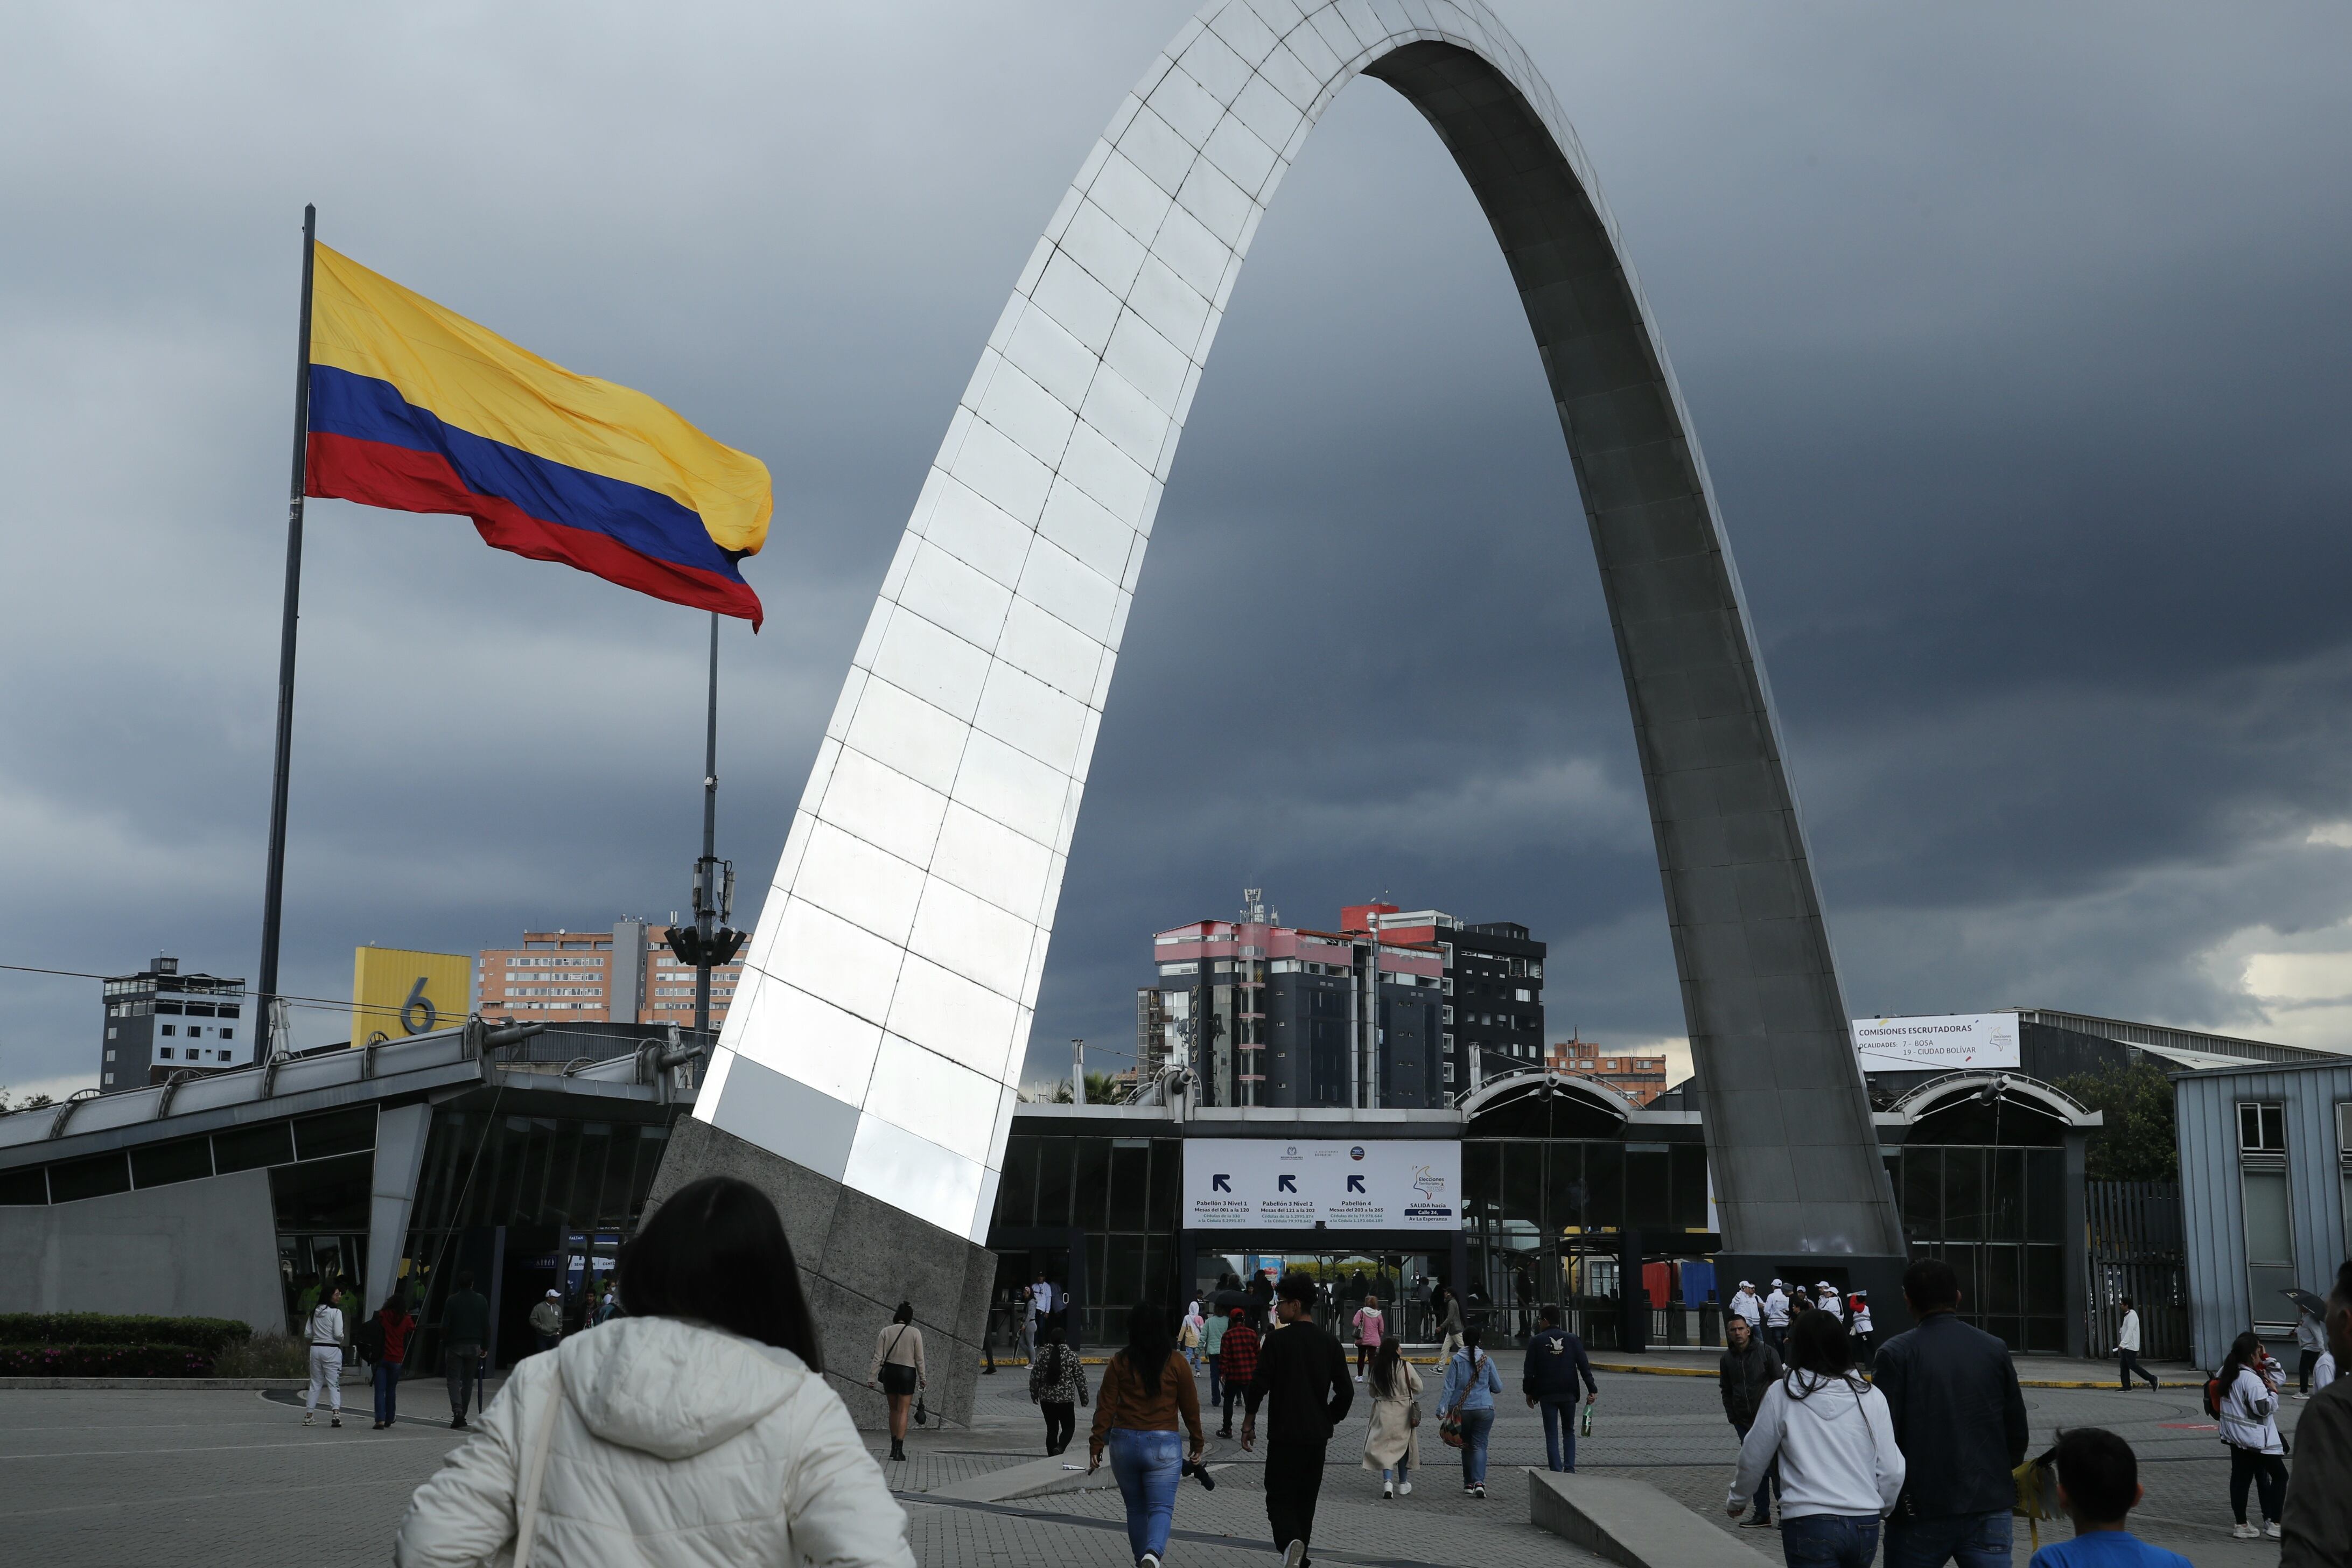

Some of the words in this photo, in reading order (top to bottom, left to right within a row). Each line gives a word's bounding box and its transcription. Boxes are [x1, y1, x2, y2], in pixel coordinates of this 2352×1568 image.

[401, 977, 435, 1034] 6
[1191, 985, 1199, 1063] HOTEL
[1859, 1028, 1906, 1036] COMISIONES
[1908, 1025, 1972, 1034] ESCRUTADORAS
[1947, 1046, 1976, 1054] BOLÍVAR
